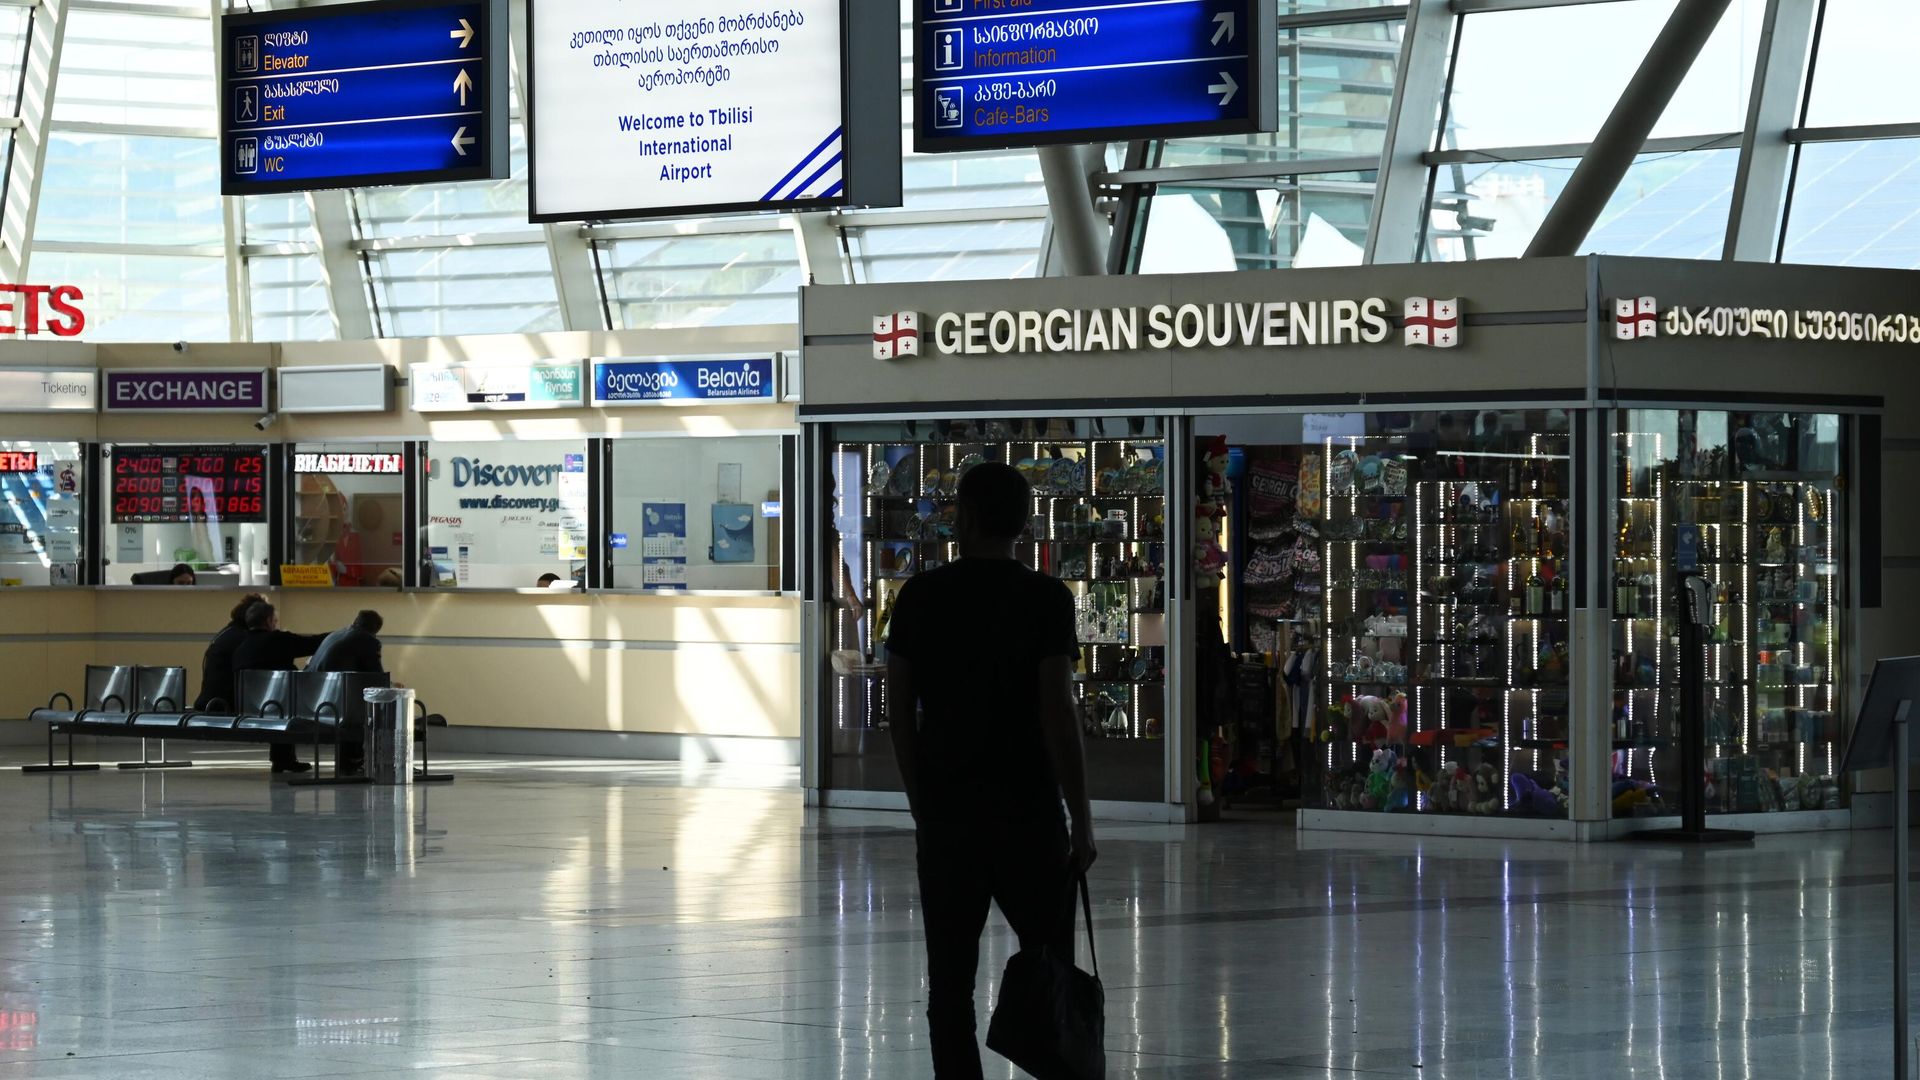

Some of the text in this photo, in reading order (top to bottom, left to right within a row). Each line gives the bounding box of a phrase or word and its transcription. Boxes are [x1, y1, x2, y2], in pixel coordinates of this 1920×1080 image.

[264, 30, 308, 47] ლიფტი
[569, 10, 804, 49] კეთილი იყოს თქვენი მობრძანება
[973, 17, 1099, 44] საინფორმაციო
[264, 53, 309, 71] Elevator
[593, 38, 779, 69] თბილისის საერთაშორისო
[974, 46, 1056, 68] Information
[264, 78, 339, 98] გასასვლელი
[638, 65, 731, 91] აეროპორტში
[974, 79, 1057, 102] კაფე-ბარი
[264, 105, 285, 121] Exit
[618, 106, 753, 132] Welcome to Tbilisi
[264, 131, 324, 151] ტუალეტი
[639, 134, 732, 157] International
[264, 156, 284, 173] WC
[660, 162, 712, 183] Airport
[935, 297, 1389, 355] GEORGIAN SOUVENIRS
[1665, 305, 1788, 339] ქართული
[607, 369, 679, 392] ბელავია
[698, 362, 760, 388] Belavia
[41, 381, 87, 397] Ticketing
[116, 380, 253, 401] EXCHANGE
[707, 387, 760, 397] Belarusian Airlines
[116, 457, 161, 474] 2400
[234, 457, 262, 473] 125
[116, 477, 161, 493] 2600
[115, 497, 161, 513] 2090
[227, 497, 262, 513] 866
[430, 516, 462, 524] PEGASUS
